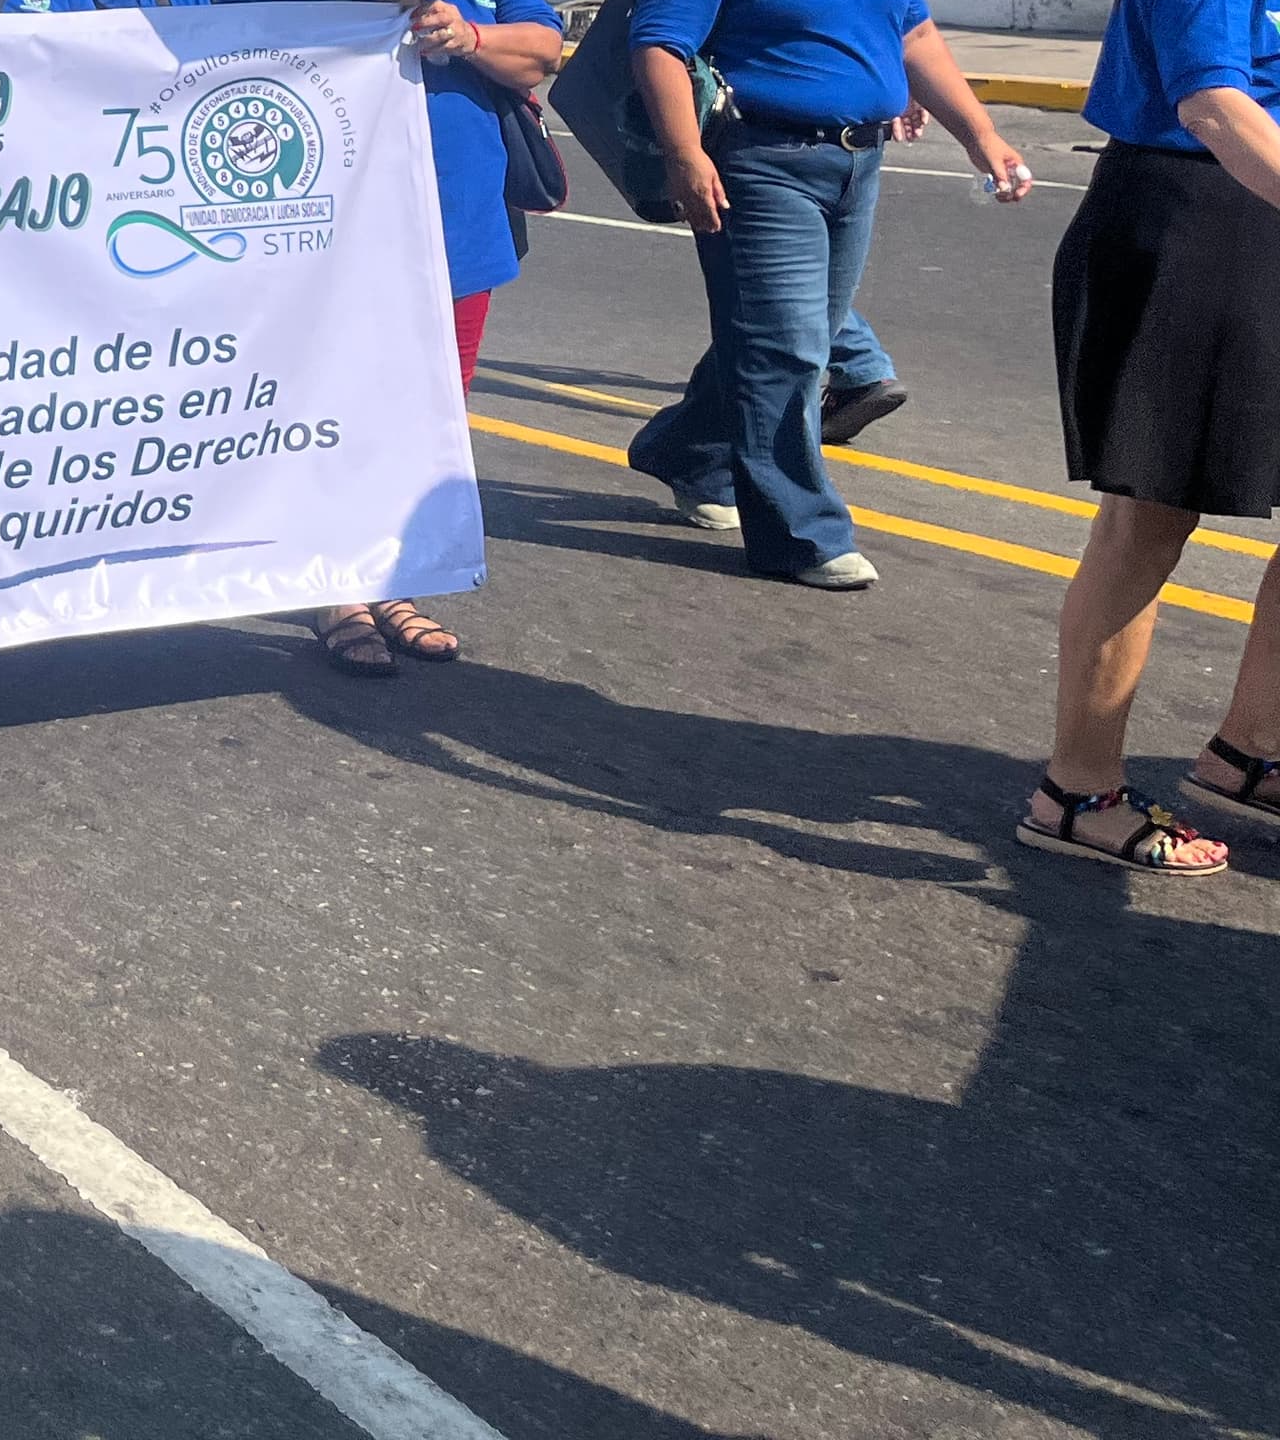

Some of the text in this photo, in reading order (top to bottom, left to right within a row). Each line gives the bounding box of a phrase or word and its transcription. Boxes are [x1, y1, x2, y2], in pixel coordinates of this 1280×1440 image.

[149, 46, 358, 169] #OrgullosamenteTelefonista
[191, 85, 248, 132] TELEFONISTAS
[249, 84, 261, 95] DE
[262, 85, 275, 98] LA
[102, 107, 176, 185] 75
[188, 133, 199, 146] DE
[188, 150, 217, 197] SINDICATO
[296, 140, 318, 187] MEXICANA
[105, 188, 176, 202] ANIVERSARIO
[221, 205, 269, 224] DEMOCRACIA
[270, 204, 277, 220] Y
[277, 203, 300, 220] LUCHA
[262, 227, 334, 256] STRM
[93, 332, 153, 374] de
[168, 328, 238, 368] los
[178, 383, 232, 420] en
[243, 372, 278, 412] la
[47, 446, 117, 486] los
[130, 418, 341, 477] Derechos
